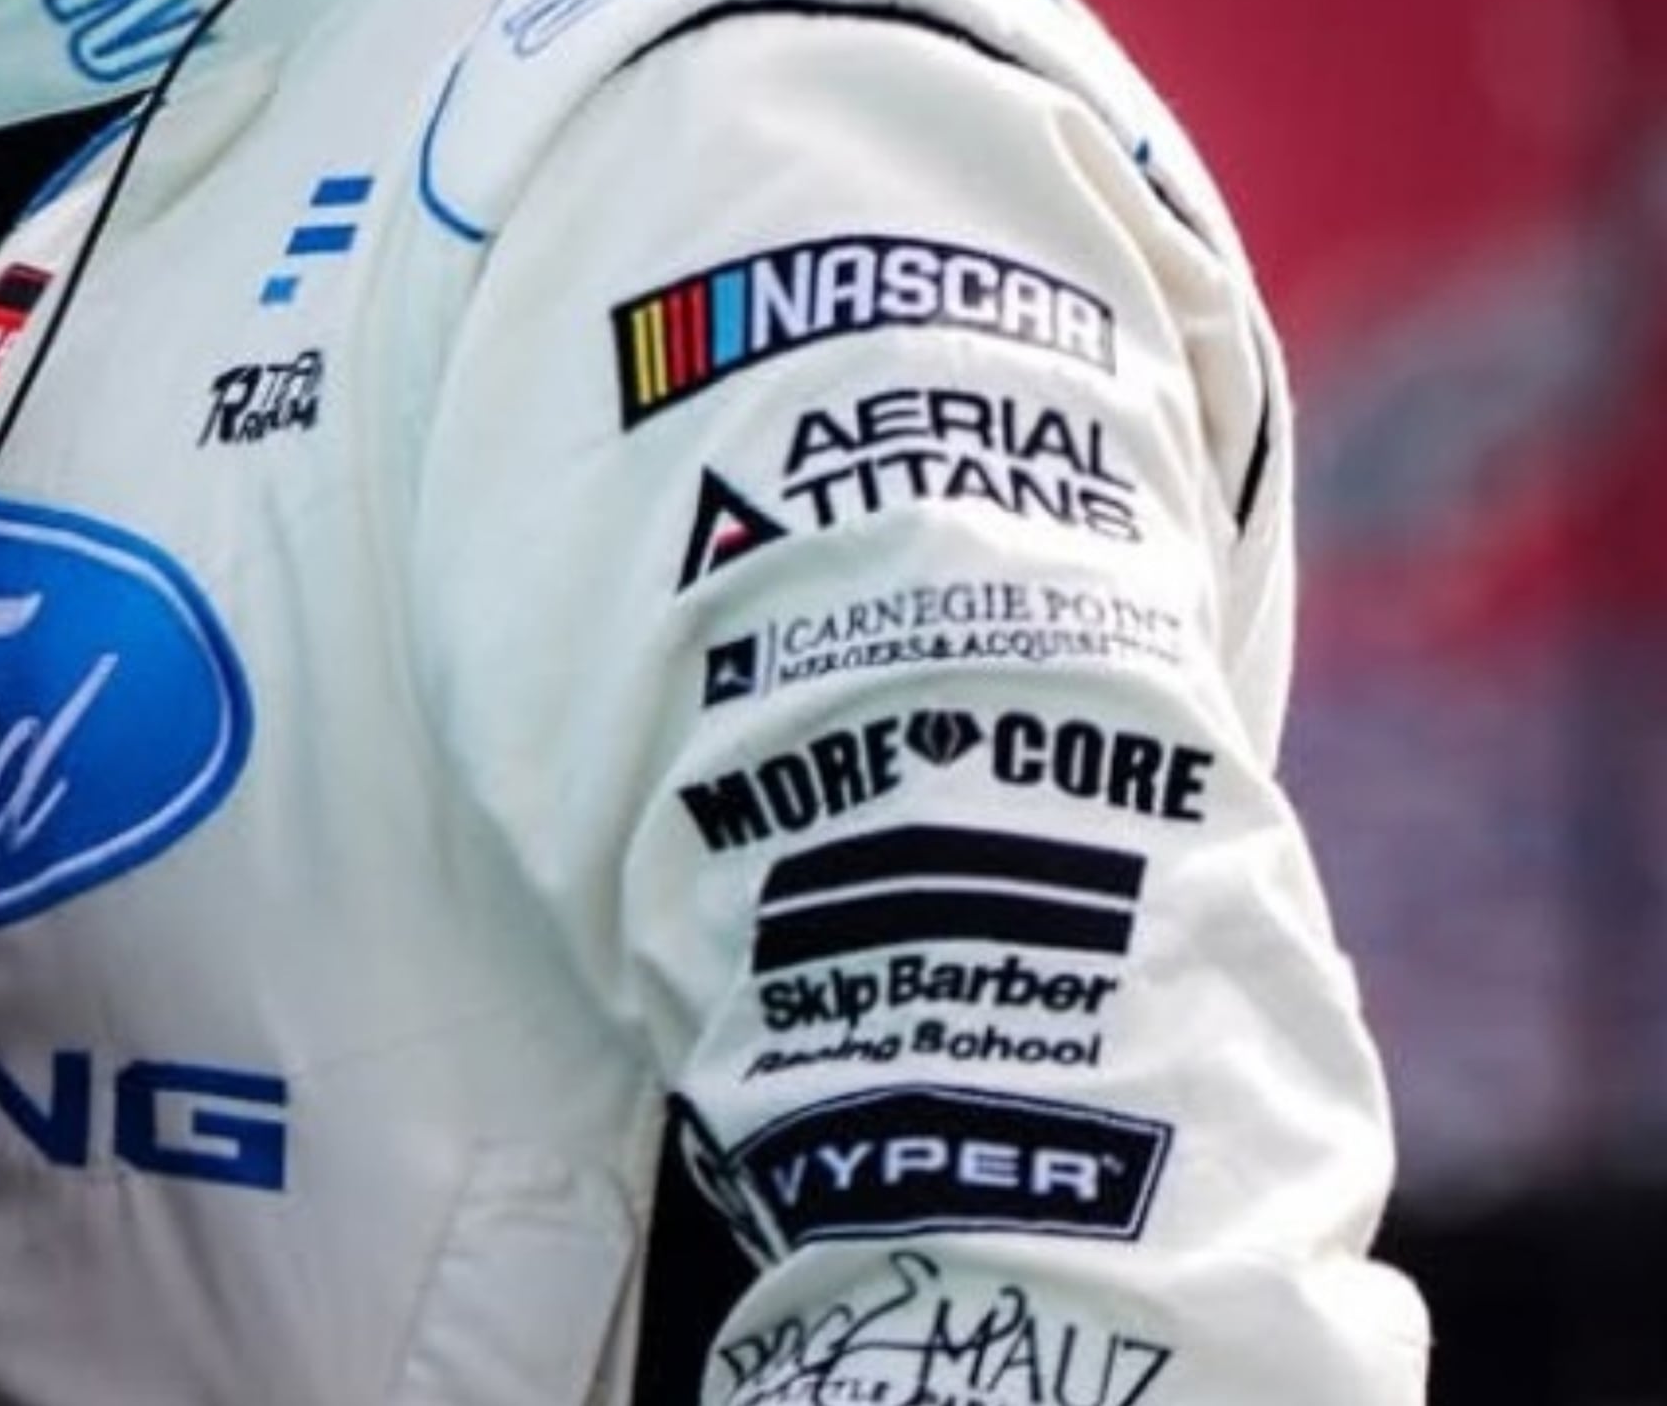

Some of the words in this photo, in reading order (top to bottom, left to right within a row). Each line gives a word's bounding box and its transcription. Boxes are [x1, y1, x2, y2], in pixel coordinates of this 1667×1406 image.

[751, 244, 1109, 366] NASCAR
[783, 389, 1137, 494] AERIAL
[780, 450, 1145, 544] TITANS
[782, 581, 1030, 655] CARNEGIE
[677, 715, 903, 853] MORE
[991, 710, 1215, 823] CORE
[759, 966, 881, 1034] Skip
[887, 953, 1118, 1015] Barber
[910, 1019, 1103, 1068] School
[772, 1135, 1103, 1208] VYPER
